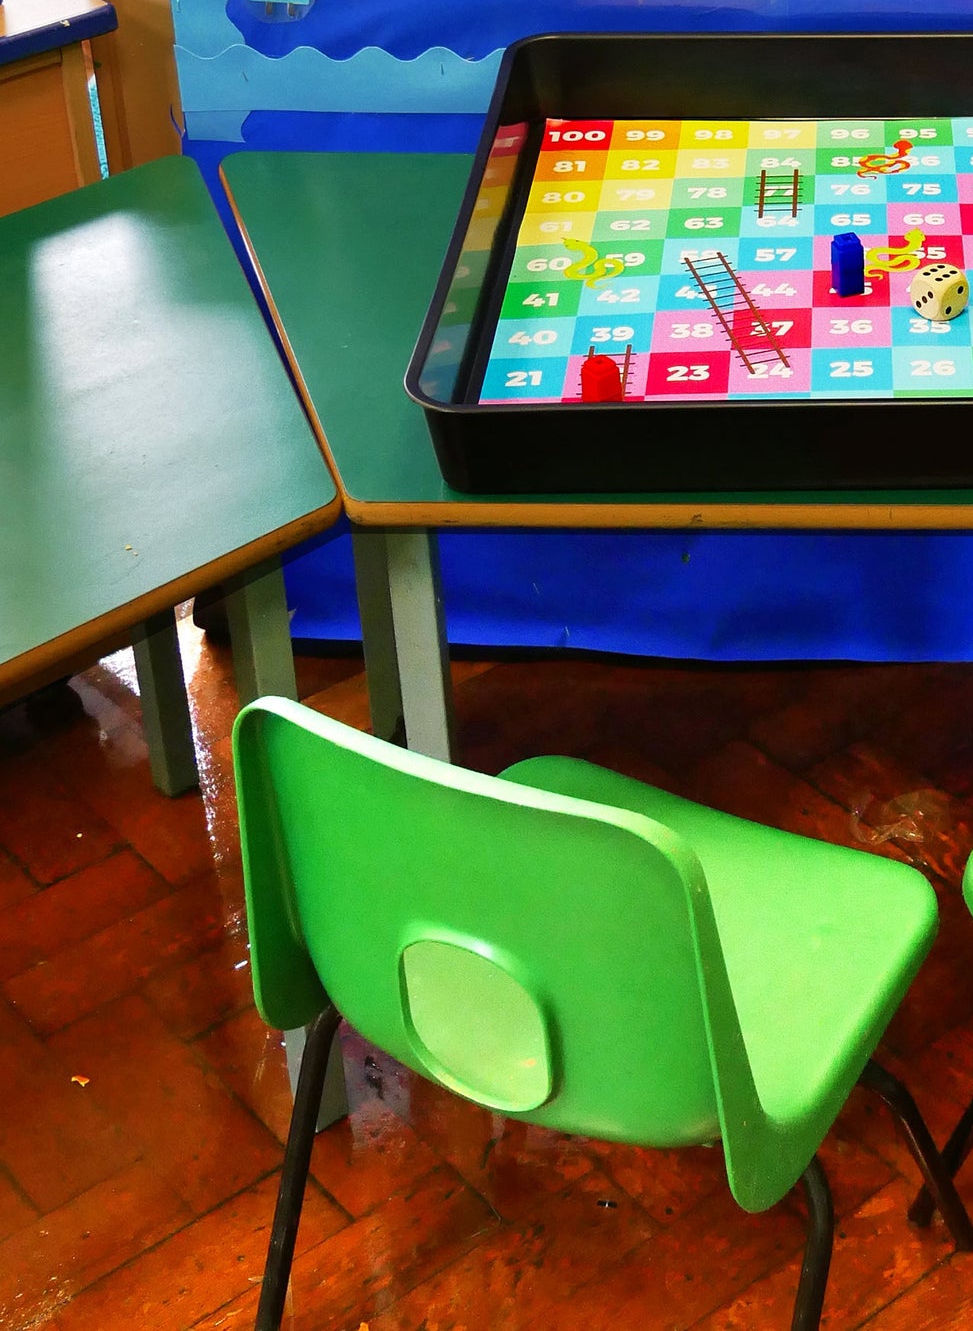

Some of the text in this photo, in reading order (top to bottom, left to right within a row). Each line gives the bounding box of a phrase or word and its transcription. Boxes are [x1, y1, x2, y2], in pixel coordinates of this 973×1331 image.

[548, 130, 606, 142] 100
[626, 130, 666, 141] 99
[694, 129, 733, 140] 98
[763, 129, 802, 140] 97
[830, 128, 870, 140] 96
[898, 128, 938, 139] 95
[553, 160, 587, 173] 81
[621, 159, 660, 171] 82
[691, 158, 730, 169] 83
[760, 157, 802, 168] 84
[541, 191, 586, 204] 80
[616, 189, 656, 201] 79
[687, 187, 728, 199] 78
[830, 184, 871, 196] 76
[902, 183, 942, 196] 75
[539, 220, 573, 233] 61
[610, 219, 651, 231] 62
[683, 216, 724, 230] 63
[756, 216, 799, 228] 64
[830, 213, 872, 226] 65
[903, 213, 946, 226] 66
[526, 257, 573, 272] 60
[754, 248, 797, 262] 57
[522, 292, 560, 308] 41
[596, 288, 641, 304] 42
[752, 283, 797, 297] 44
[508, 329, 558, 346] 40
[590, 326, 635, 342] 39
[670, 322, 714, 339] 38
[750, 320, 794, 337] 37
[829, 319, 873, 334] 36
[908, 318, 951, 334] 35
[504, 370, 543, 387] 21
[666, 365, 710, 381] 23
[747, 363, 794, 379] 24
[829, 361, 874, 377] 25
[910, 360, 956, 376] 26
